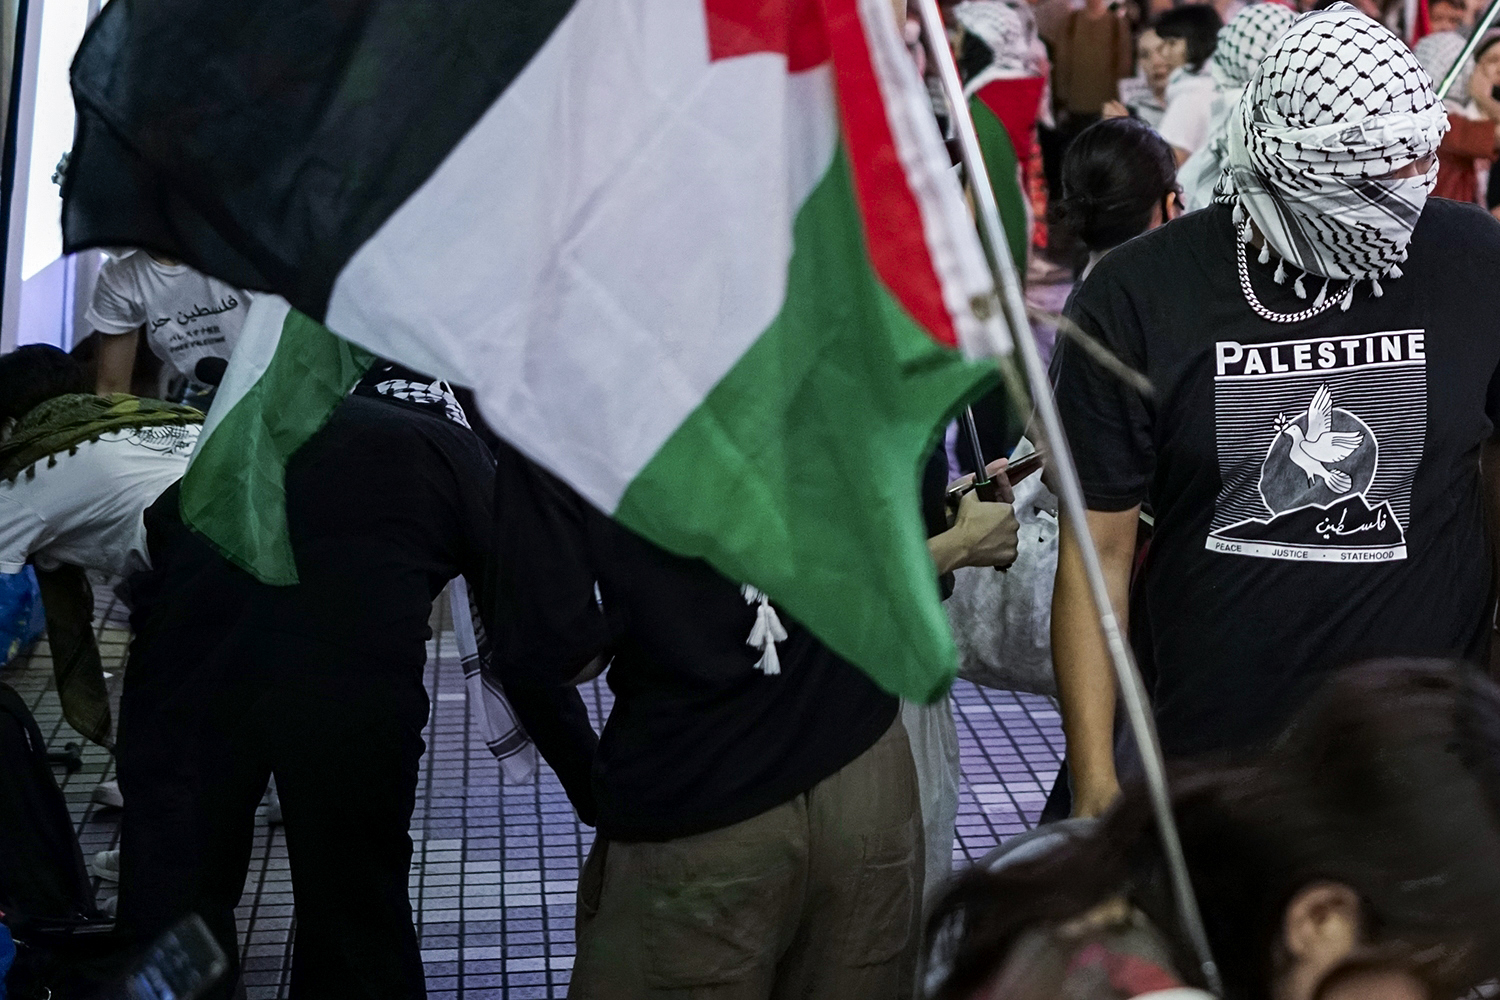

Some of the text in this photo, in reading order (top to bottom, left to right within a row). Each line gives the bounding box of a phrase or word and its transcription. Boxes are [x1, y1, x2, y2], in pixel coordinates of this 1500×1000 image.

[177, 294, 239, 326] فلسطين
[1215, 333, 1426, 376] PALESTINE
[1315, 506, 1387, 540] فلسطين
[1215, 542, 1395, 561] PEACE JUSTICE STATEHOOD
